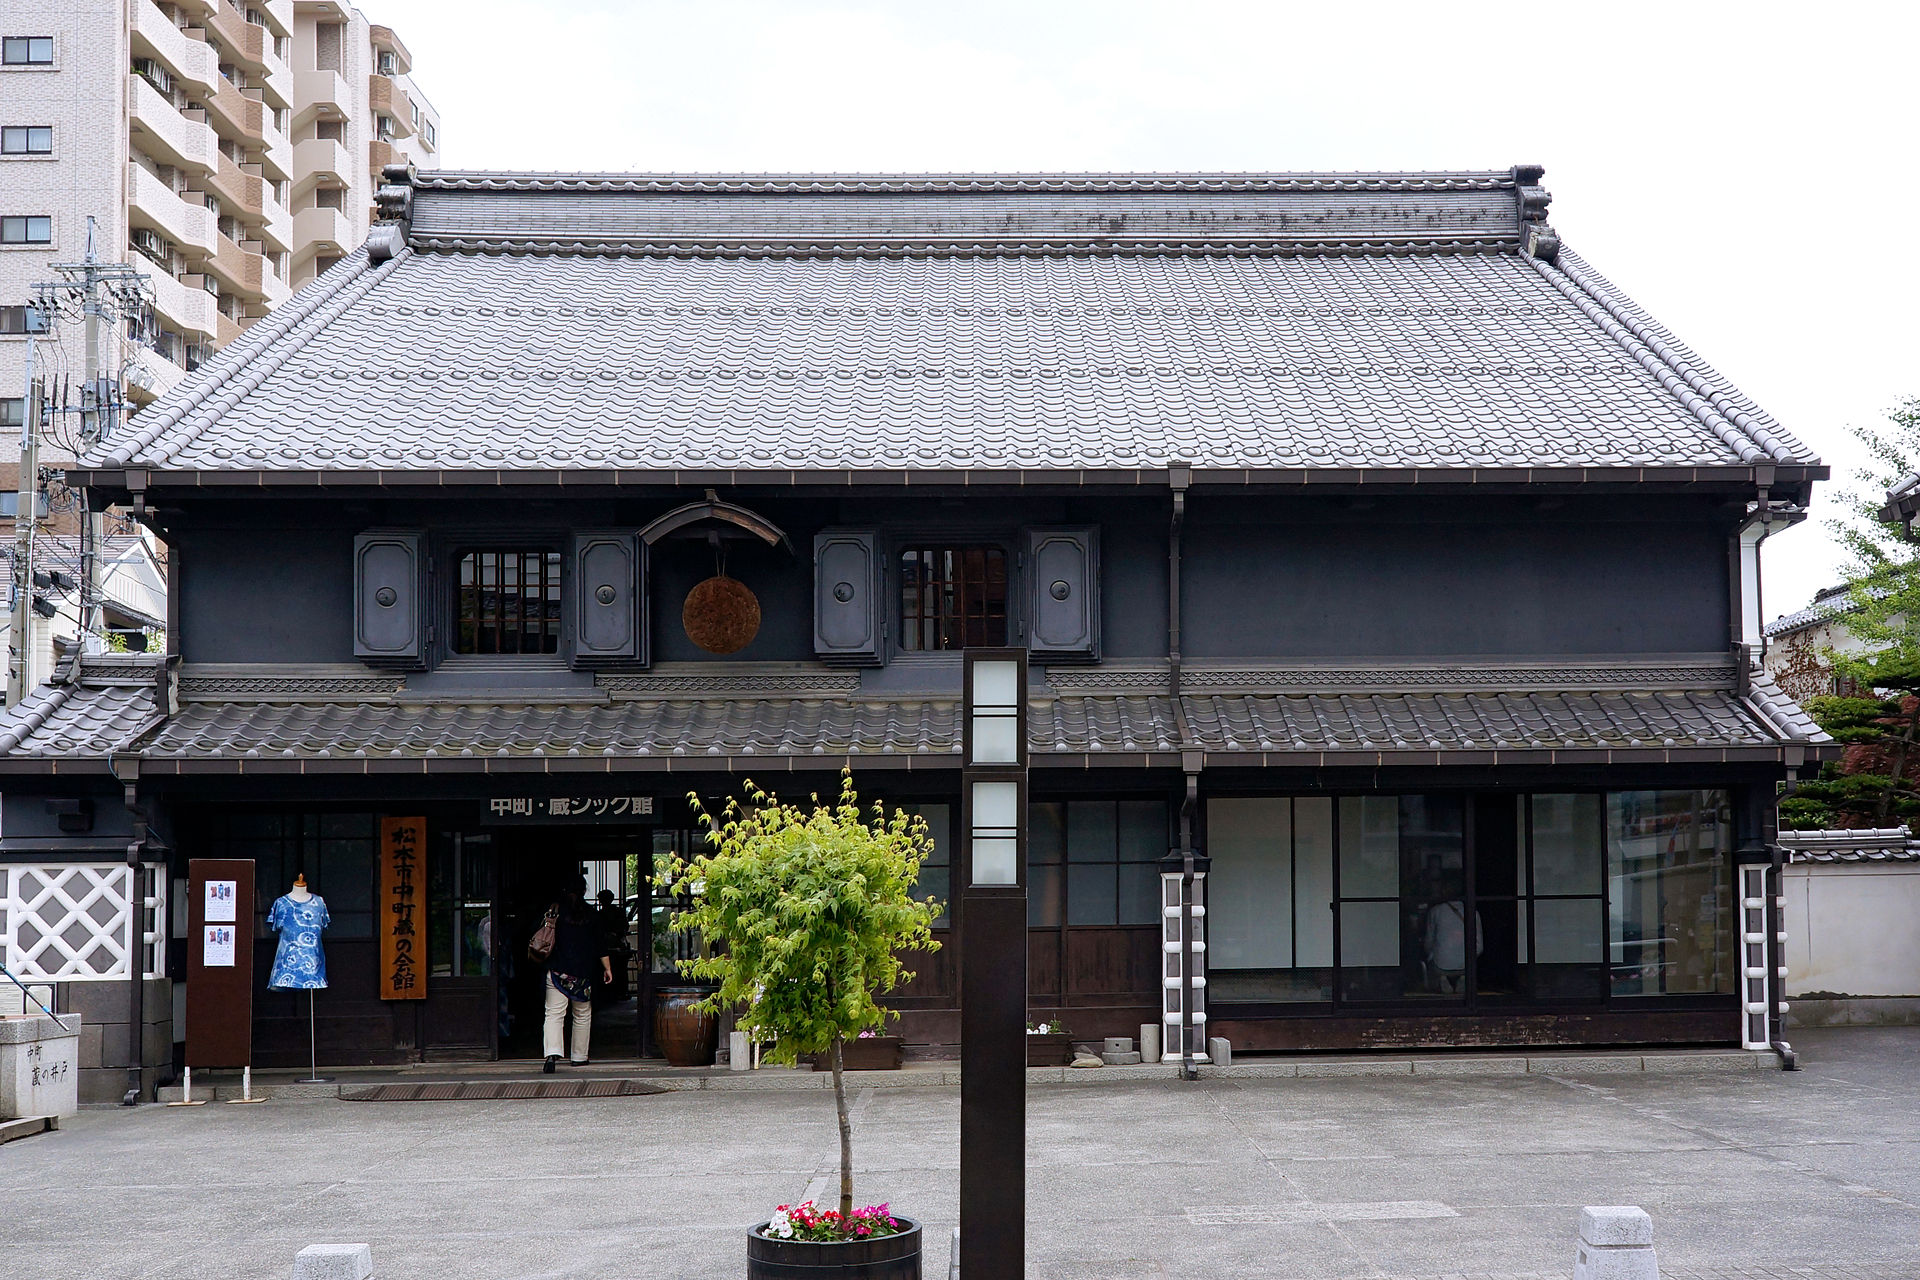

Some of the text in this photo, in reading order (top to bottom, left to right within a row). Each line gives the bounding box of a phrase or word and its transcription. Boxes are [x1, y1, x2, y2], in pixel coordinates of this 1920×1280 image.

[390, 826, 417, 991] 松本市中町蔵の会館
[27, 1045, 42, 1063] 中町
